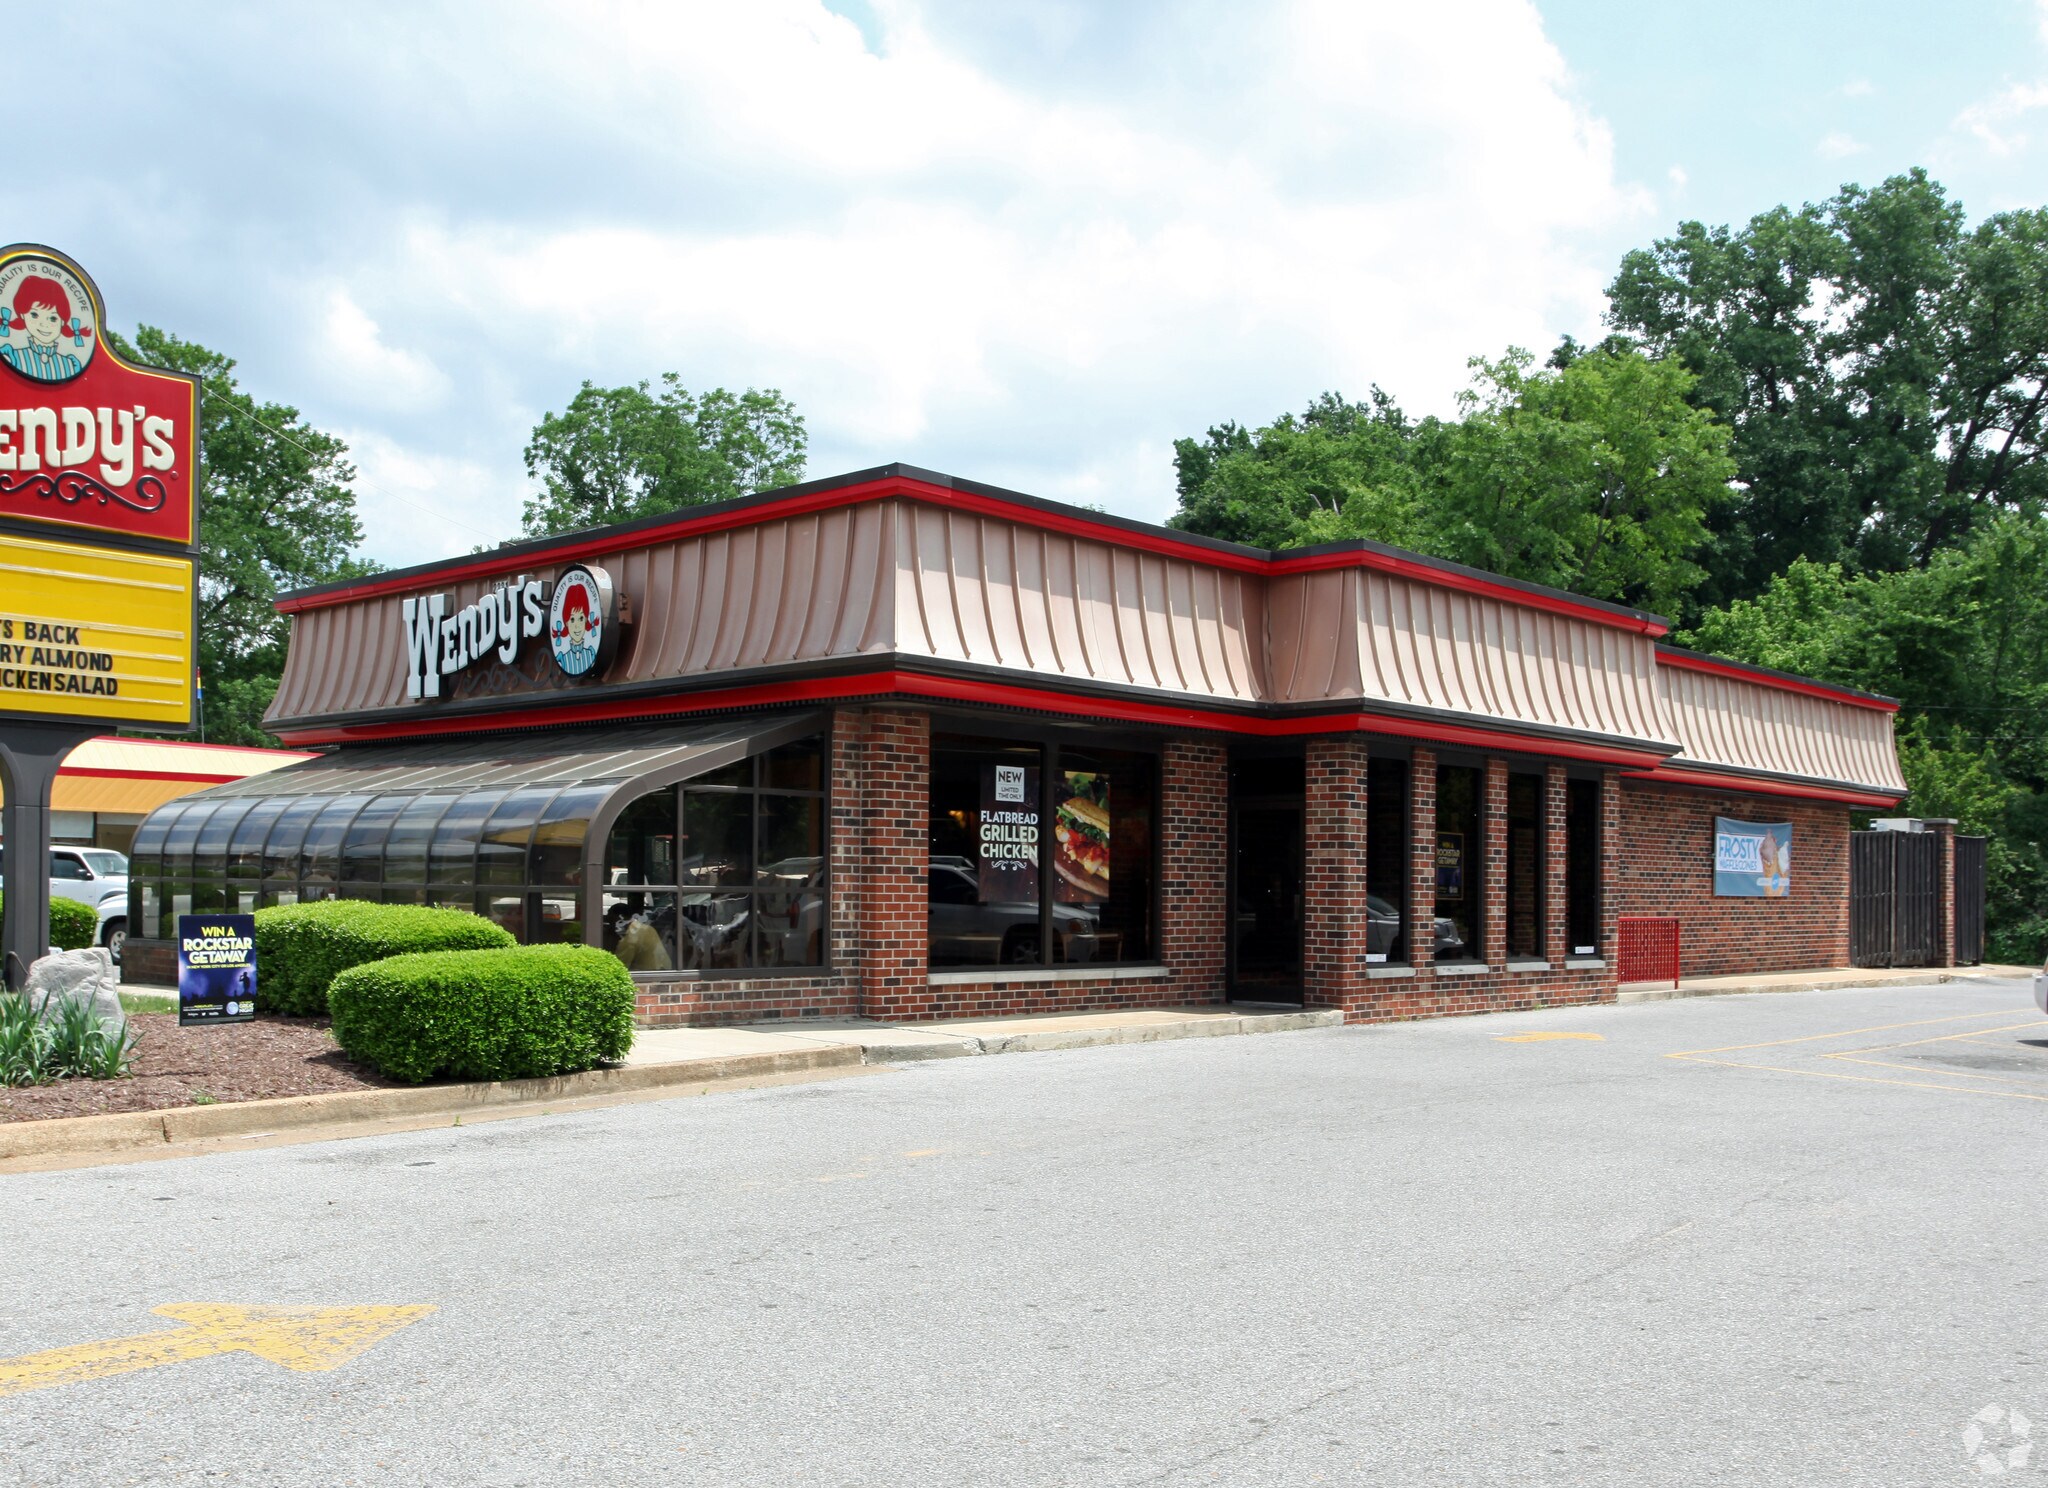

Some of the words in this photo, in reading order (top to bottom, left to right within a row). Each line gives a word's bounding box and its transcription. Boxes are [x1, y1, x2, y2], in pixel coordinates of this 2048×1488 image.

[27, 264, 37, 272] IS
[42, 265, 62, 280] OUR
[64, 278, 89, 312] RECIPE
[552, 580, 567, 612] QUALITY
[24, 621, 80, 646] BACK
[31, 646, 114, 672] ALMOND
[998, 770, 1023, 783] NEW
[980, 810, 1038, 825] FLATBREAD
[980, 824, 1039, 843] GRILLED
[980, 843, 1038, 859] CHICKEN
[1718, 836, 1760, 859] FROSTY
[201, 926, 225, 937] WIN
[227, 926, 236, 937] A
[183, 937, 253, 951] ROCKSTAR
[189, 950, 248, 964] GETAWAY
